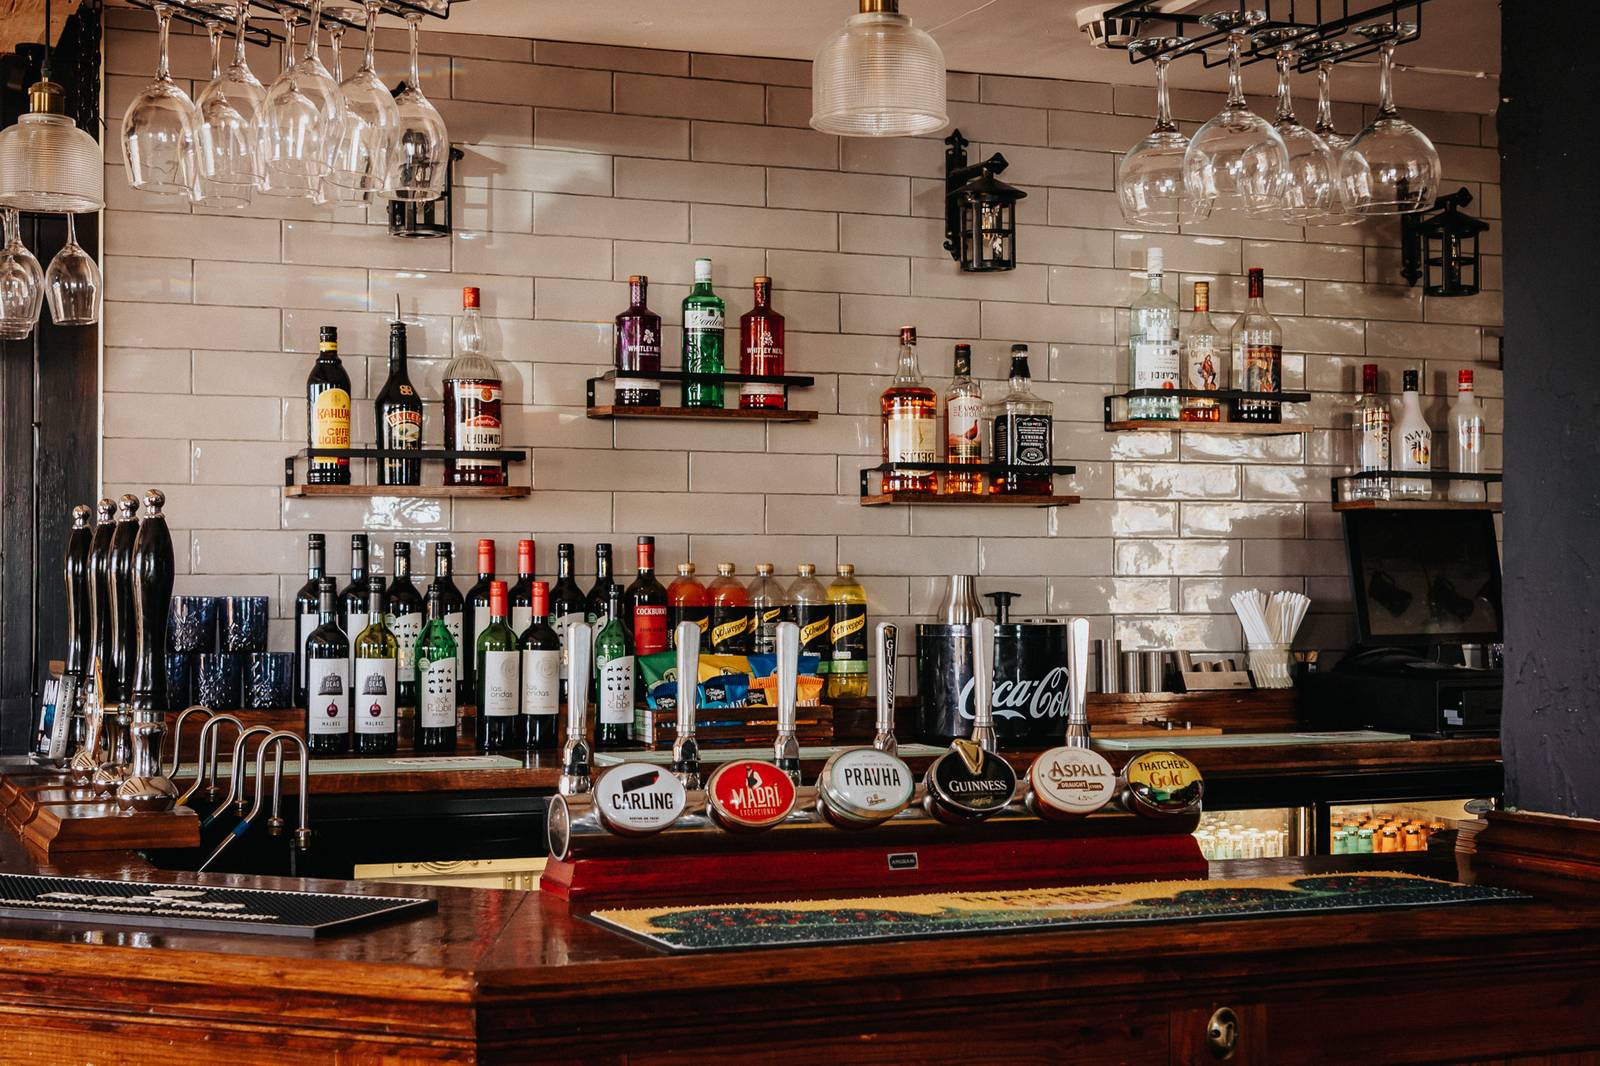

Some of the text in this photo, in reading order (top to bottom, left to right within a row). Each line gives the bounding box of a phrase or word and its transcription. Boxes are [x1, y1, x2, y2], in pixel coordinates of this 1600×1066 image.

[886, 639, 894, 703] GUINNESS
[958, 666, 1070, 720] Cca-Col
[1048, 760, 1108, 782] ASPALL
[1138, 760, 1190, 772] THATCHERS
[844, 767, 902, 787] PRAVHA
[948, 780, 1008, 793] GUINNESS
[1060, 781, 1087, 789] DRAUGHT
[1149, 770, 1184, 788] Gold
[611, 792, 674, 811] CARLING
[731, 783, 781, 810] MADRÍ
